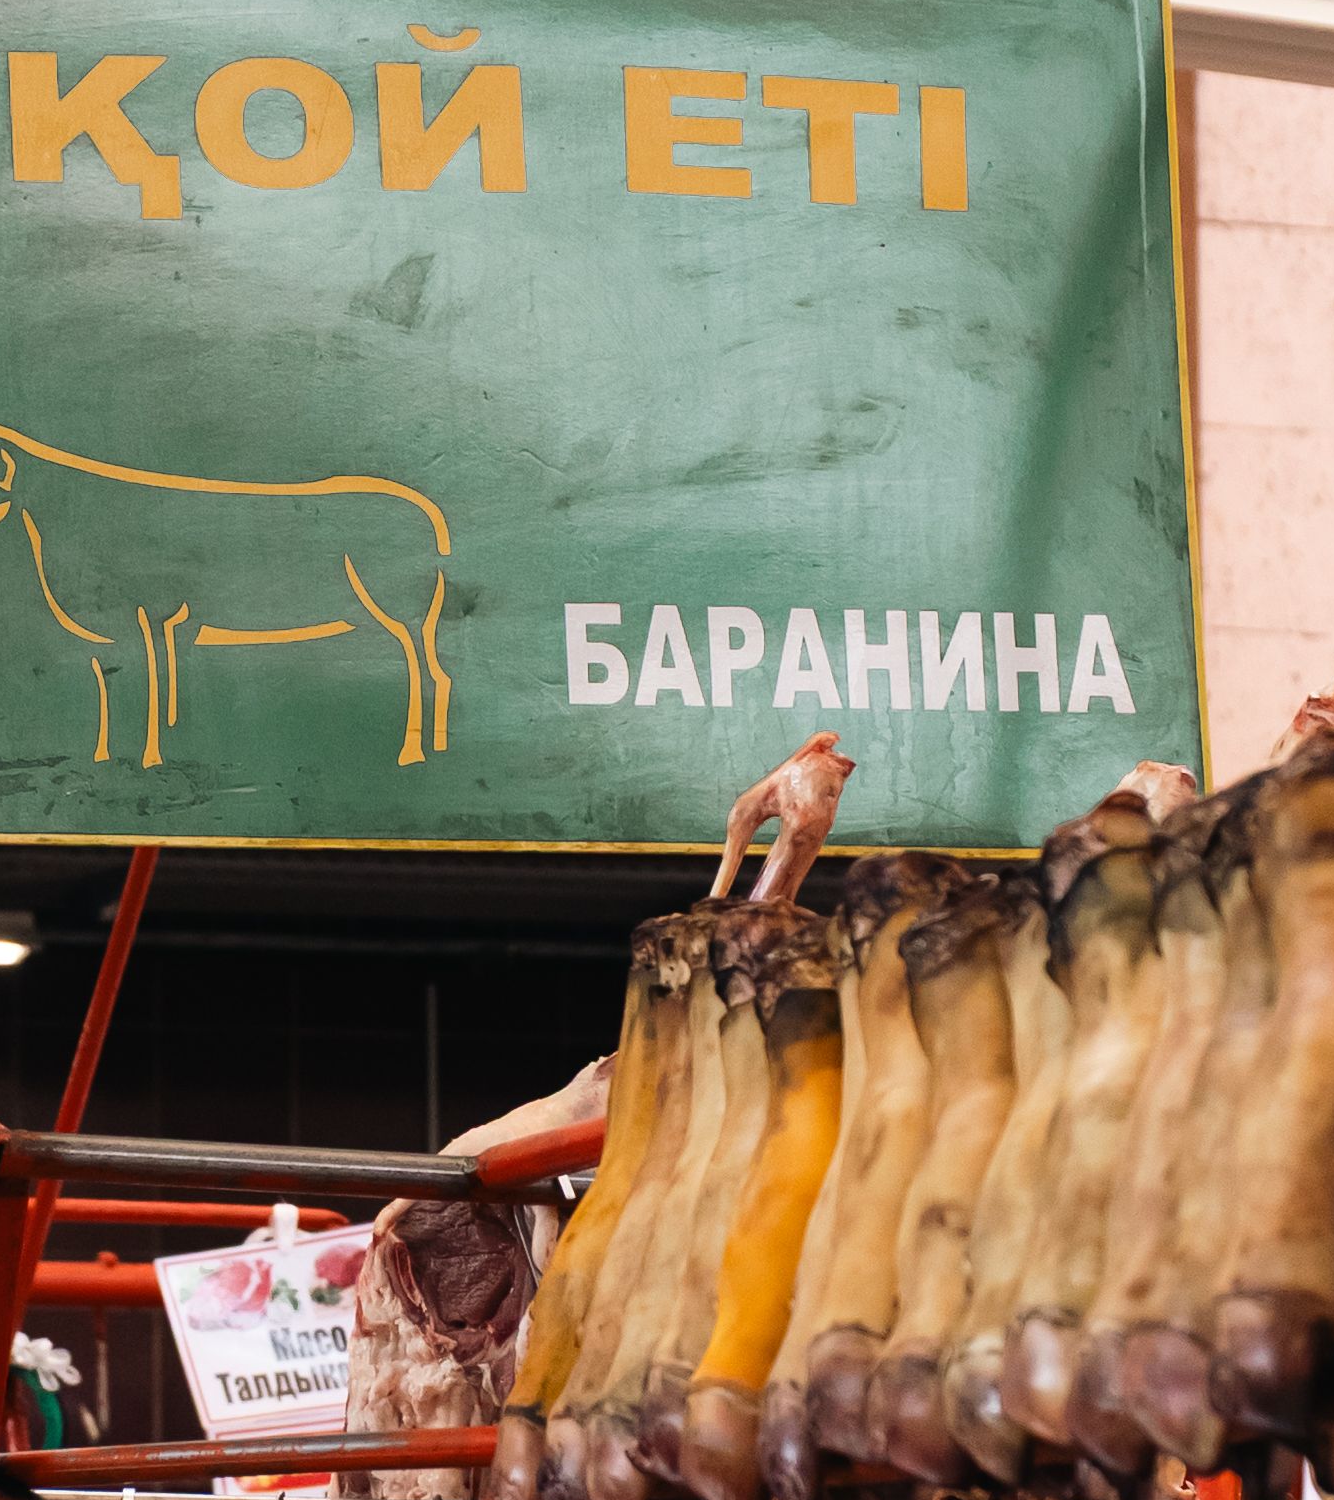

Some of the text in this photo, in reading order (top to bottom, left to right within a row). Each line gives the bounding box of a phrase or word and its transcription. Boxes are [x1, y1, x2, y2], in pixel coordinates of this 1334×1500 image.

[7, 22, 970, 221] ҚОЙ ЕТІ
[562, 600, 1137, 716] БАРАНИНА
